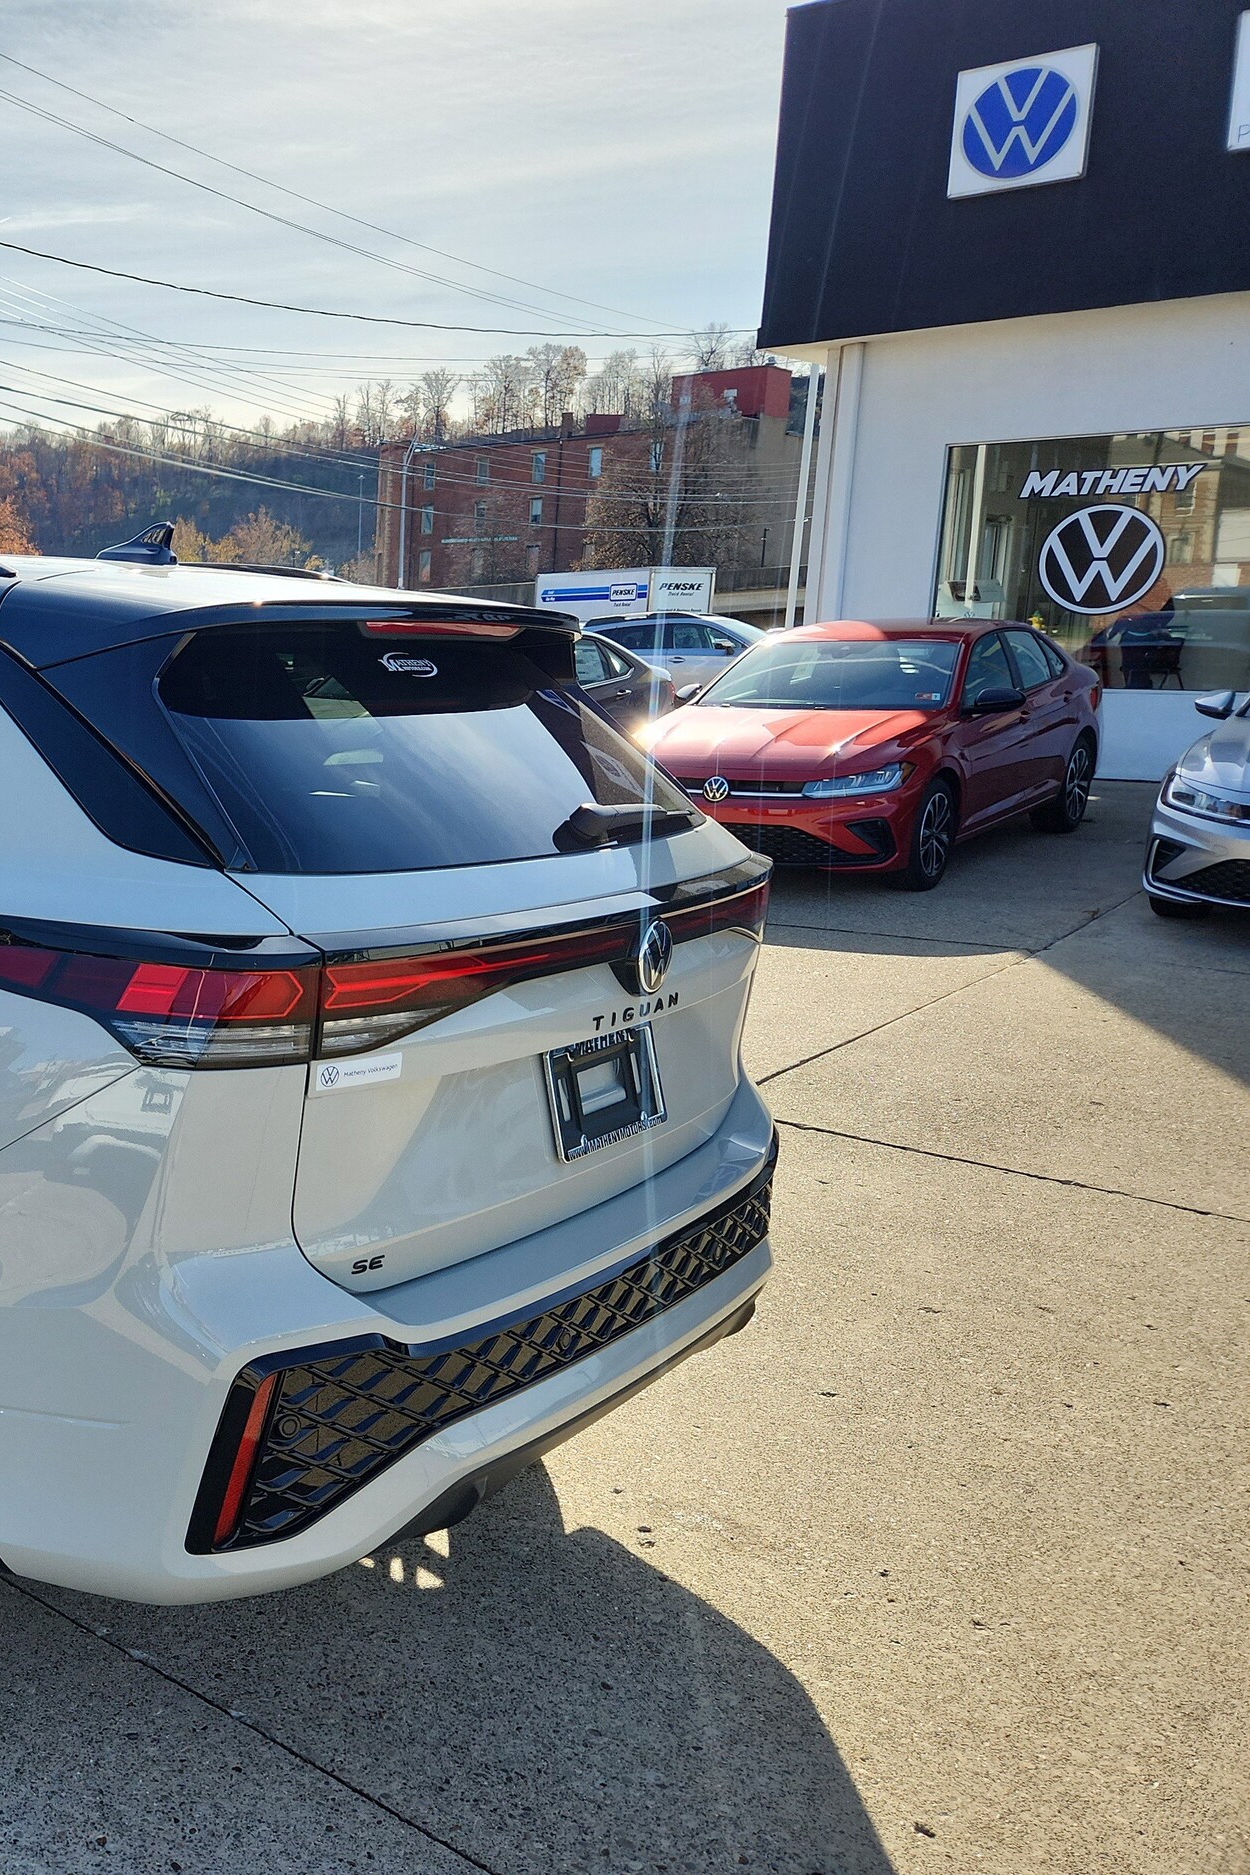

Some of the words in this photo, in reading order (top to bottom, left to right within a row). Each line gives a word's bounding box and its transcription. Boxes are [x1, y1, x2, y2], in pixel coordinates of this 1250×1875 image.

[1019, 463, 1207, 499] MATHENY
[612, 588, 635, 597] PENSKE
[659, 582, 704, 591] PENSKE
[593, 992, 679, 1031] TIGUAN
[351, 1254, 385, 1275] SE
